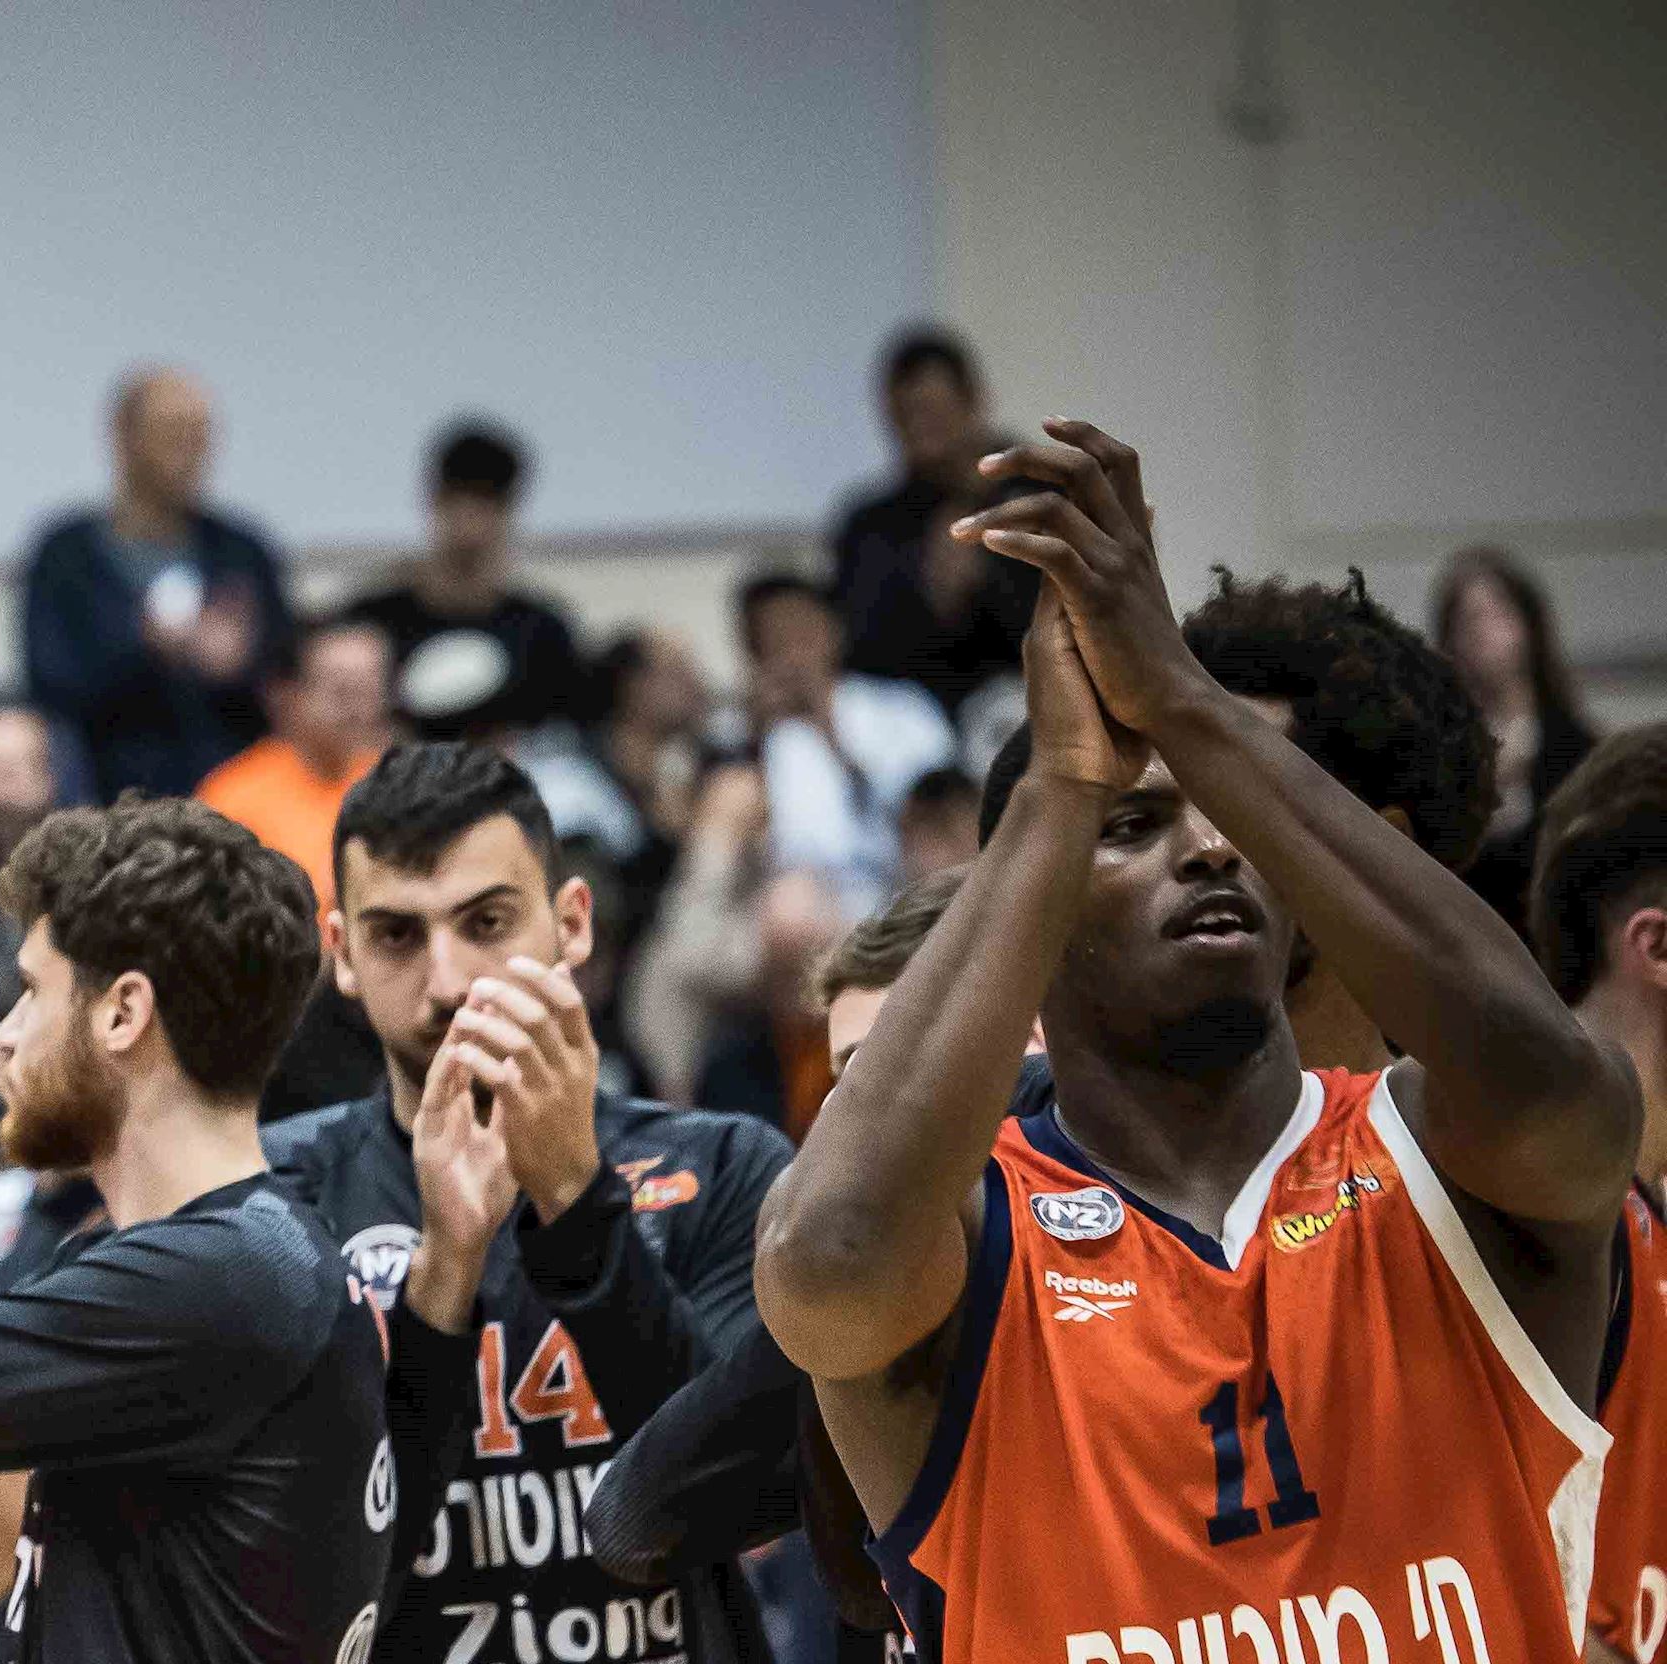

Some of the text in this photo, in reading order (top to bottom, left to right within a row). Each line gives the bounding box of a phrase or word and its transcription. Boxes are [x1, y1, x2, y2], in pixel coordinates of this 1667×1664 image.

[1044, 1269, 1139, 1298] Reebok
[473, 1318, 613, 1460] 14
[1198, 1371, 1322, 1548] 11
